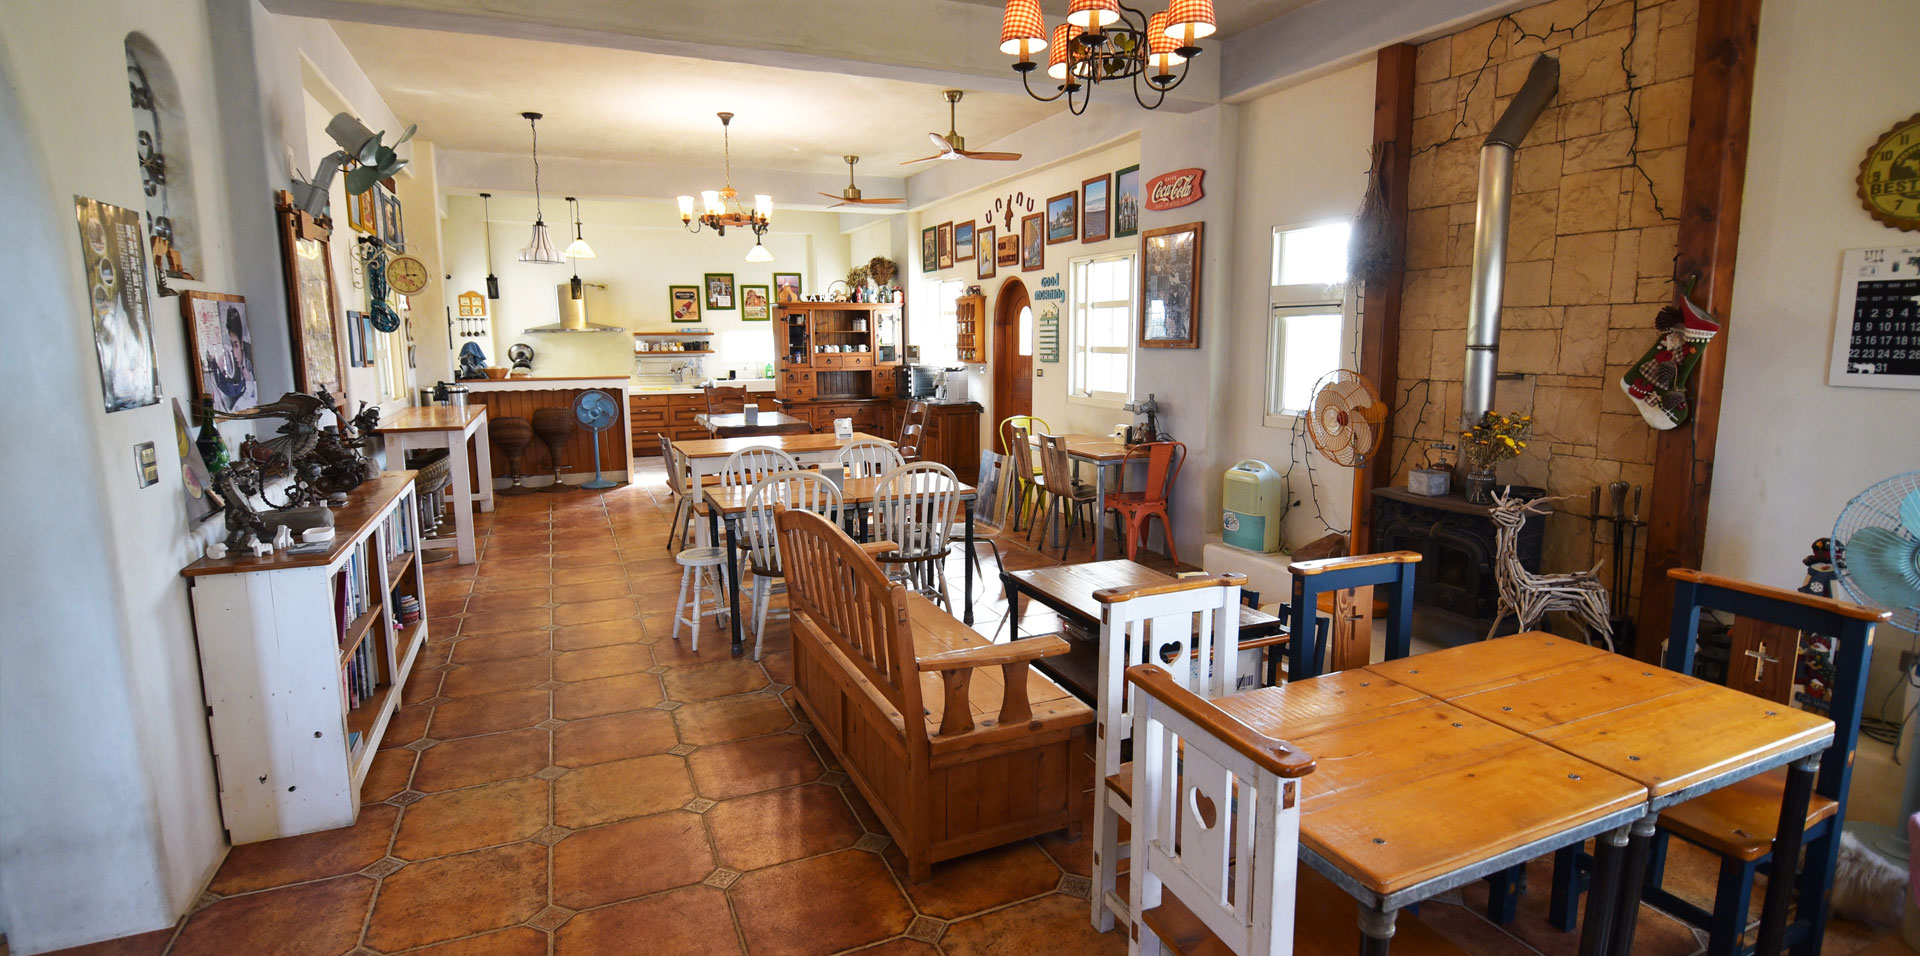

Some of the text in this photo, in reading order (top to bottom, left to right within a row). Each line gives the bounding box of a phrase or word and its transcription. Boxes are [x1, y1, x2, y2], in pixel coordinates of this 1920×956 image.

[1900, 134, 1910, 145] 11
[1881, 150, 1893, 161] 10
[1873, 171, 1881, 181] 9
[1871, 180, 1918, 195] BEST
[1895, 199, 1904, 211] 7
[1857, 308, 1863, 318] 1
[1871, 308, 1879, 318] 2
[1886, 308, 1894, 318] 3
[1901, 307, 1909, 318] 4
[1854, 321, 1861, 332] 8
[1866, 321, 1873, 332] 9
[1879, 321, 1892, 332] 10
[1894, 321, 1907, 332] 11
[1851, 335, 1862, 345] 15
[1865, 335, 1877, 345] 16
[1880, 335, 1893, 345] 17
[1896, 335, 1908, 346] 18
[1849, 349, 1860, 358] 22
[1862, 349, 1875, 359] 23
[1877, 349, 1891, 359] 24
[1892, 349, 1907, 359] 25
[1875, 362, 1888, 372] 31
